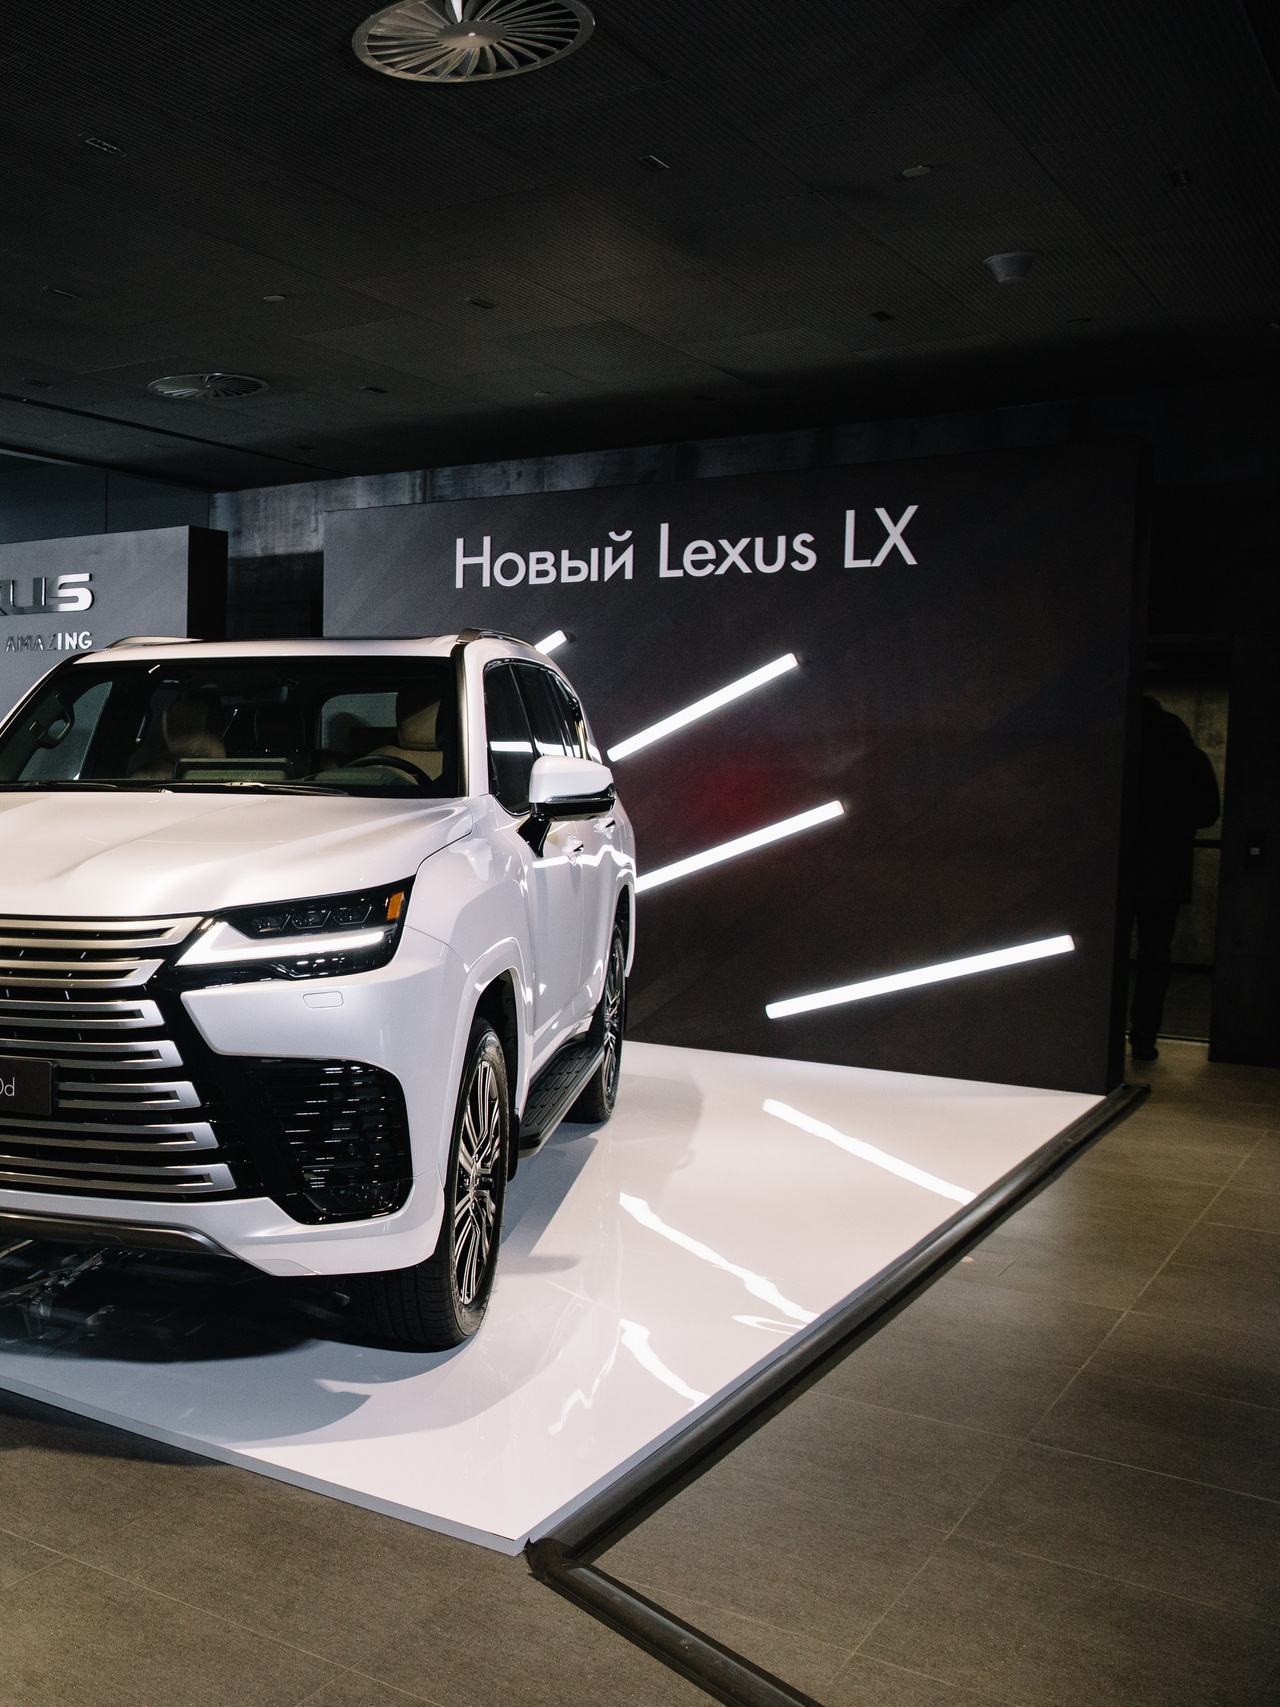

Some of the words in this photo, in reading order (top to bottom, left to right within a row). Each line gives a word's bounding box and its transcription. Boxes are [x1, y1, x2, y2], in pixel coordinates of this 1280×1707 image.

[455, 529, 634, 589] Новый
[658, 522, 818, 578] Lexus
[843, 505, 920, 569] LX
[5, 631, 94, 653] AMAZING
